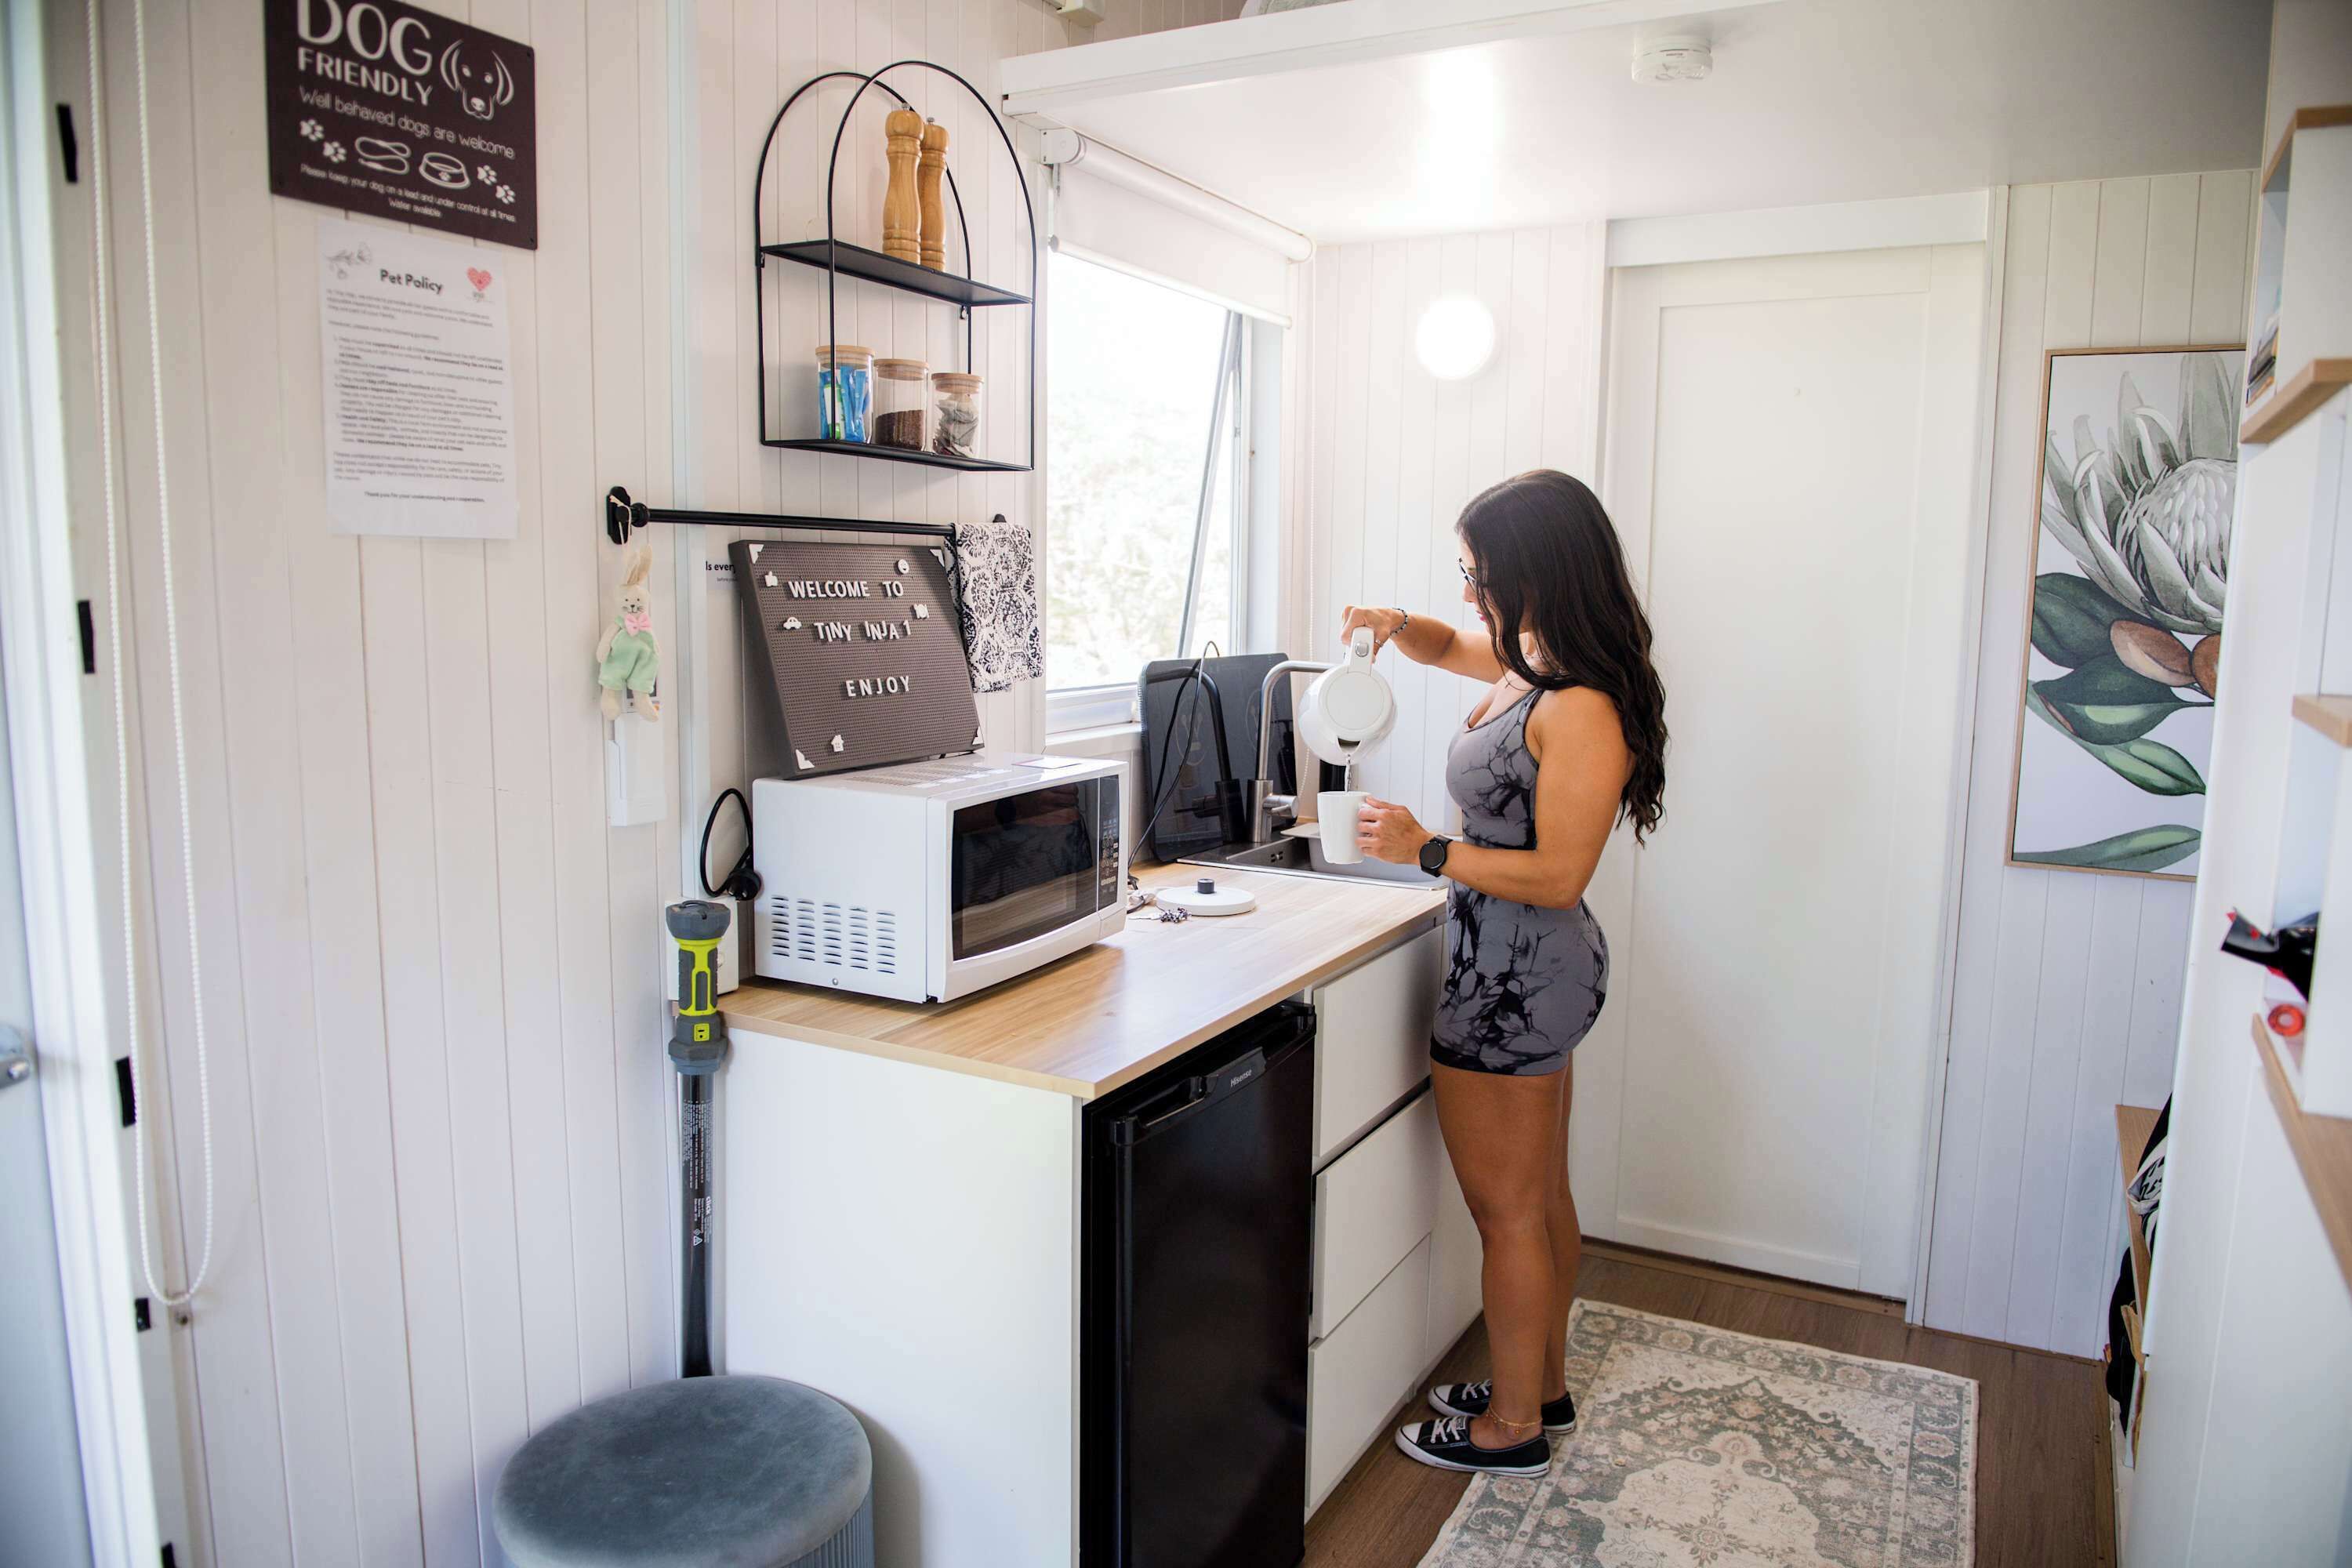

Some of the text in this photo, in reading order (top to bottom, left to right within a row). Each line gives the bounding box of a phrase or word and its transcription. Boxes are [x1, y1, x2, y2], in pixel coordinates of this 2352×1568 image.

[297, 0, 433, 76] DOG
[298, 47, 433, 106] FRIENDLY
[299, 85, 515, 160] Well behaved dogs are welcome
[369, 180, 385, 194] dog
[380, 268, 443, 295] Pet Policy
[788, 580, 904, 598] WELCOME TO
[814, 622, 851, 642] TINY
[864, 620, 899, 641] INJA
[846, 675, 909, 697] ENJOY
[1230, 1069, 1252, 1087] Hisense
